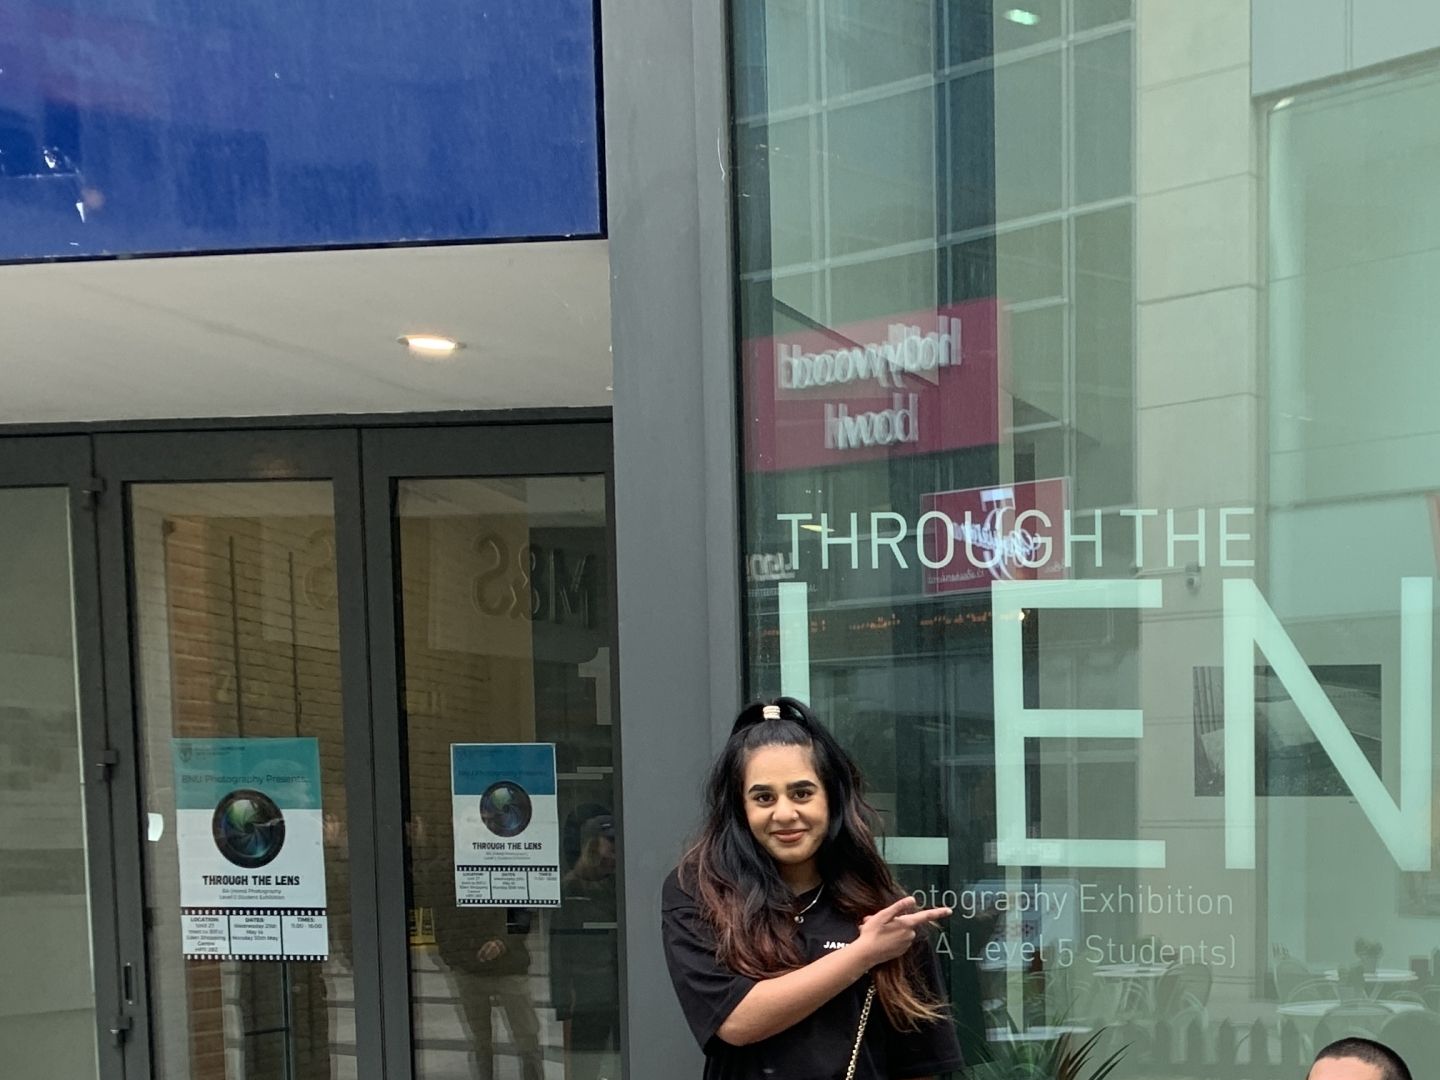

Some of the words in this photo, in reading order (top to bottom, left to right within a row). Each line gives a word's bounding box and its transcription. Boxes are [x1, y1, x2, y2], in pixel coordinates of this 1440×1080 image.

[777, 509, 1103, 570] THROUGH
[1120, 508, 1255, 567] THE
[472, 842, 505, 850] THROUGH
[508, 842, 521, 850] THE
[524, 842, 542, 850] LENS
[202, 875, 249, 886] THROUGH
[252, 875, 272, 886] THE
[275, 875, 300, 886] LENS
[911, 883, 1068, 919] otography
[1079, 884, 1234, 915] Exhibition
[966, 932, 1048, 962] Level
[1058, 939, 1074, 968] 5
[1086, 934, 1236, 968] Students)
